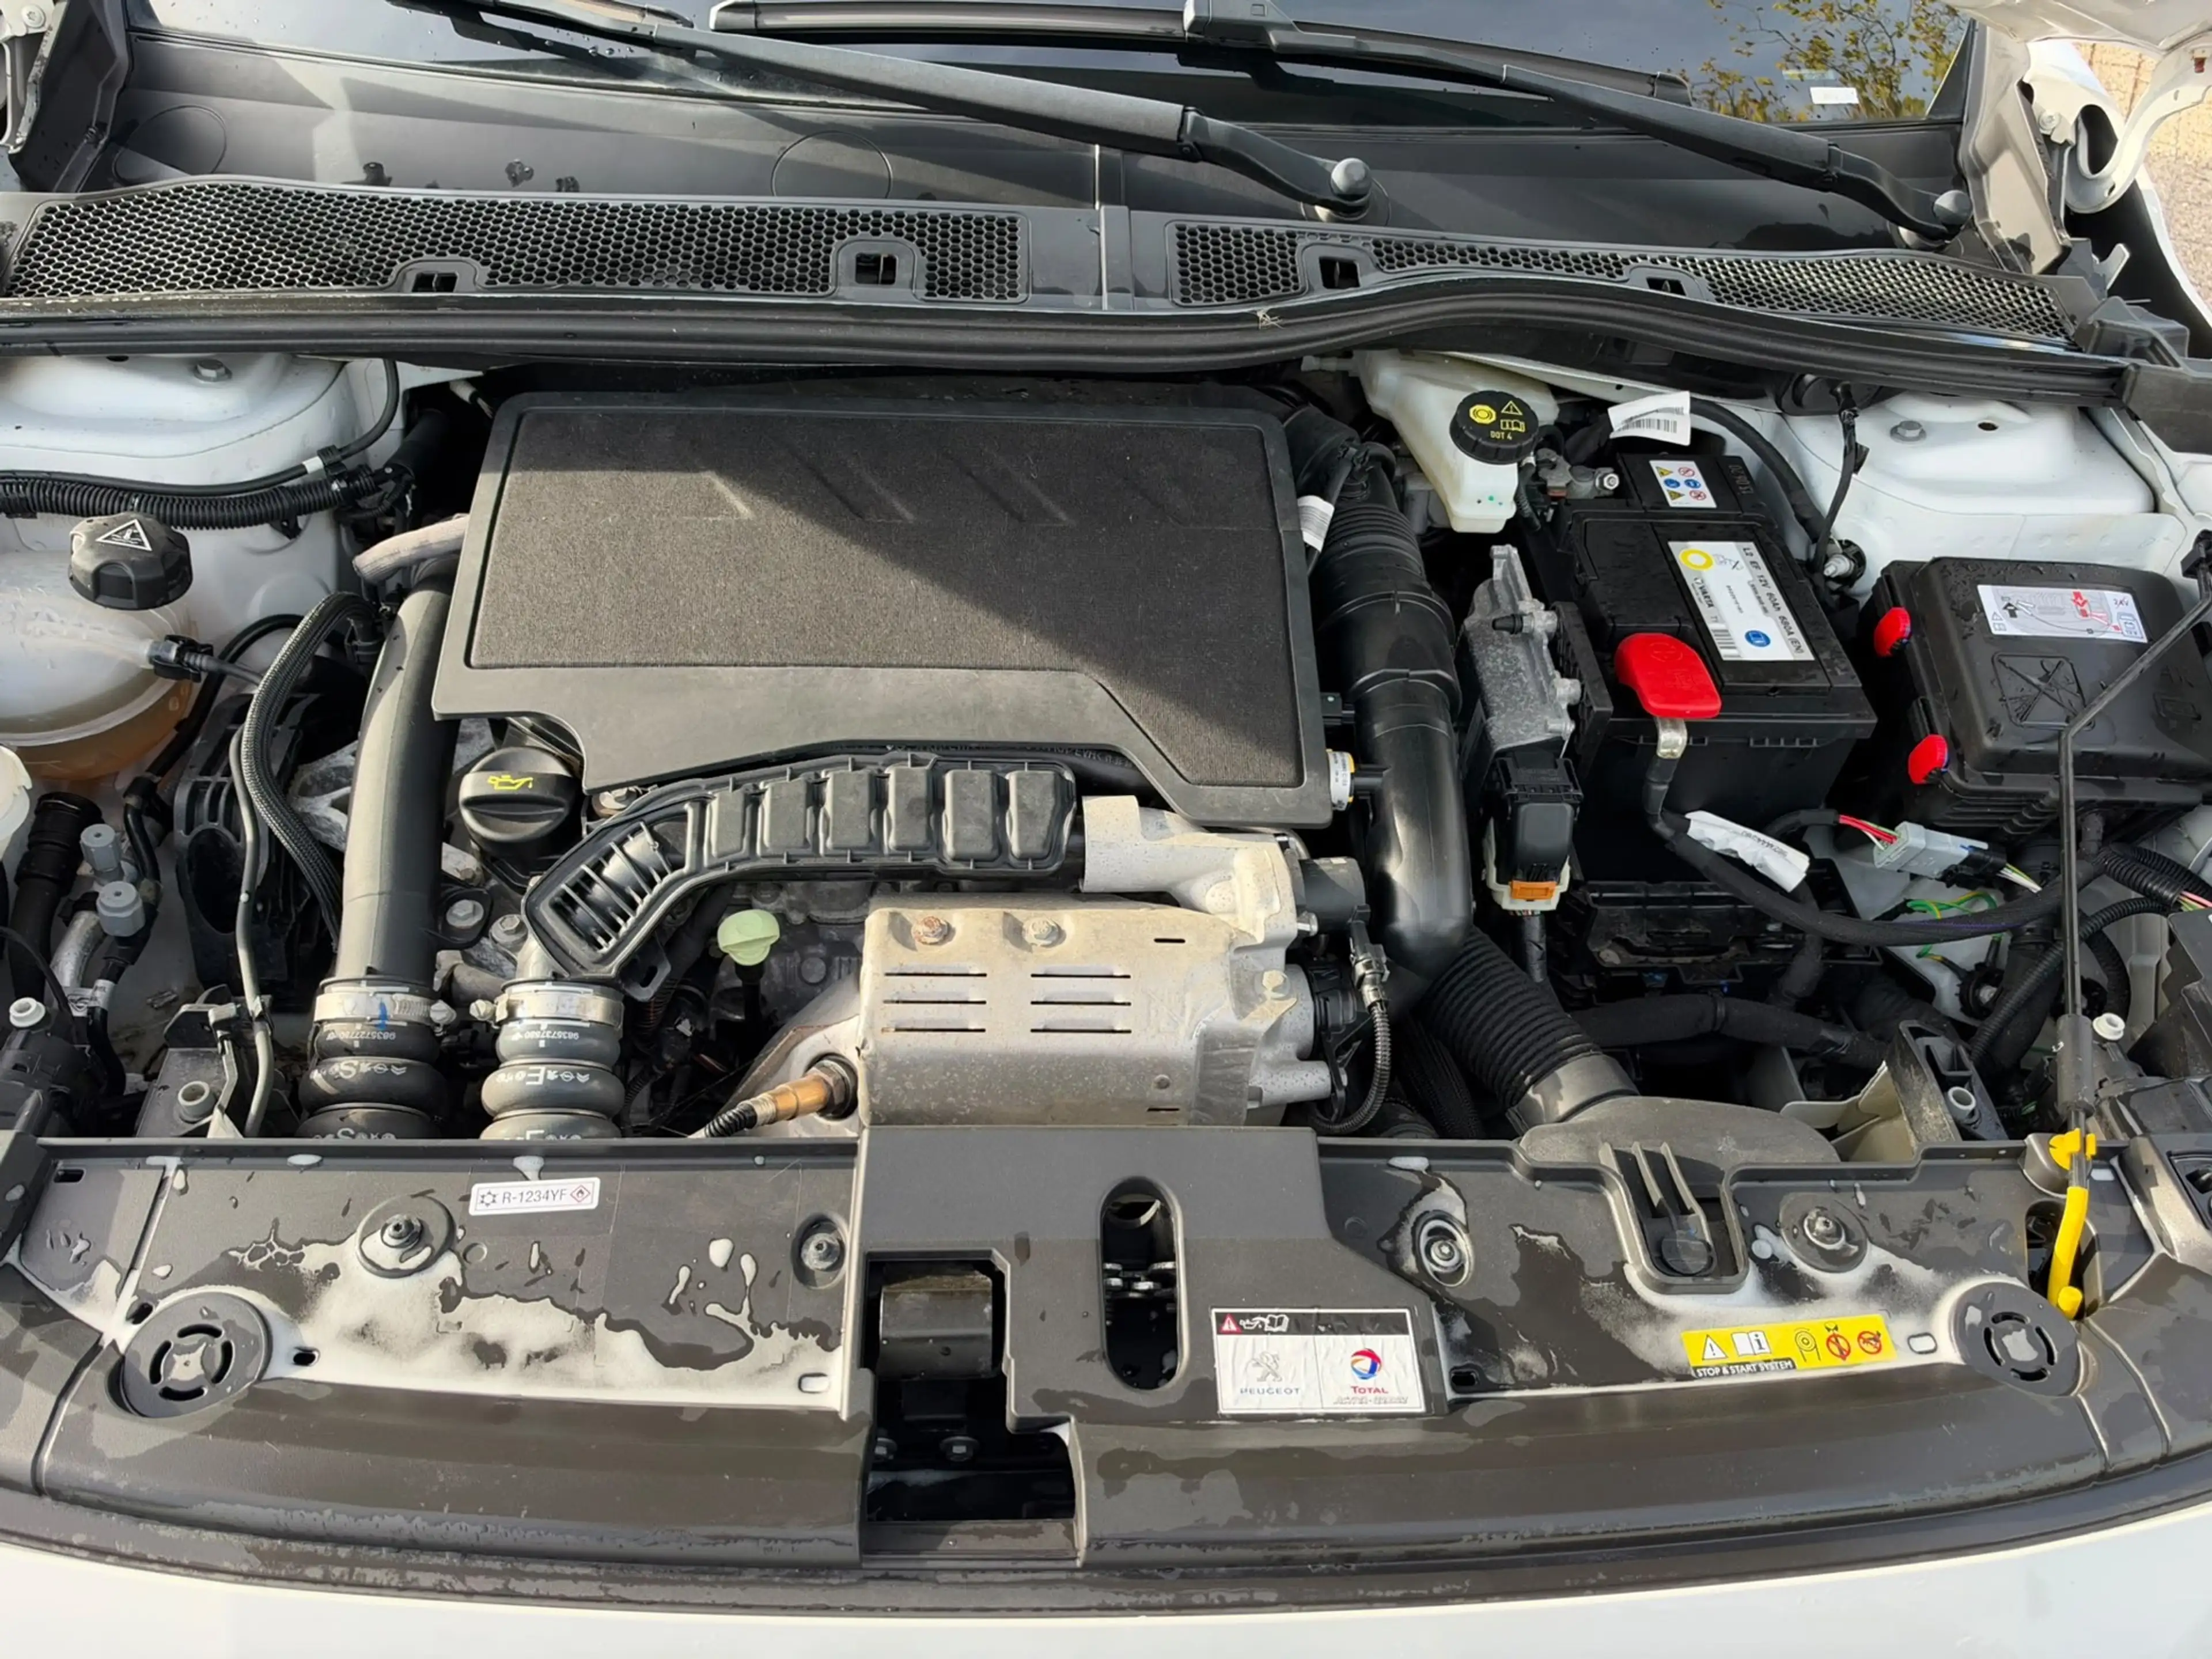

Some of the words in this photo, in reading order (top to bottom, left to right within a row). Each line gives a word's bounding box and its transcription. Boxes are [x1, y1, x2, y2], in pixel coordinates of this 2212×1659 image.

[1490, 430, 1505, 440] DOT
[1506, 432, 1513, 440] 4
[1698, 585, 1715, 608] VARTA
[1756, 574, 1771, 589] 12V
[1766, 592, 1781, 612] 60Ah
[1787, 637, 1805, 654] (EN)
[501, 1188, 568, 1205] R-1234YF
[1696, 1367, 1721, 1378] STOP
[1722, 1366, 1729, 1375] &
[1729, 1363, 1757, 1374] START
[1758, 1360, 1793, 1372] SYSTEM
[1240, 1387, 1300, 1395] PEUGEOT
[1350, 1385, 1389, 1395] TOTAL
